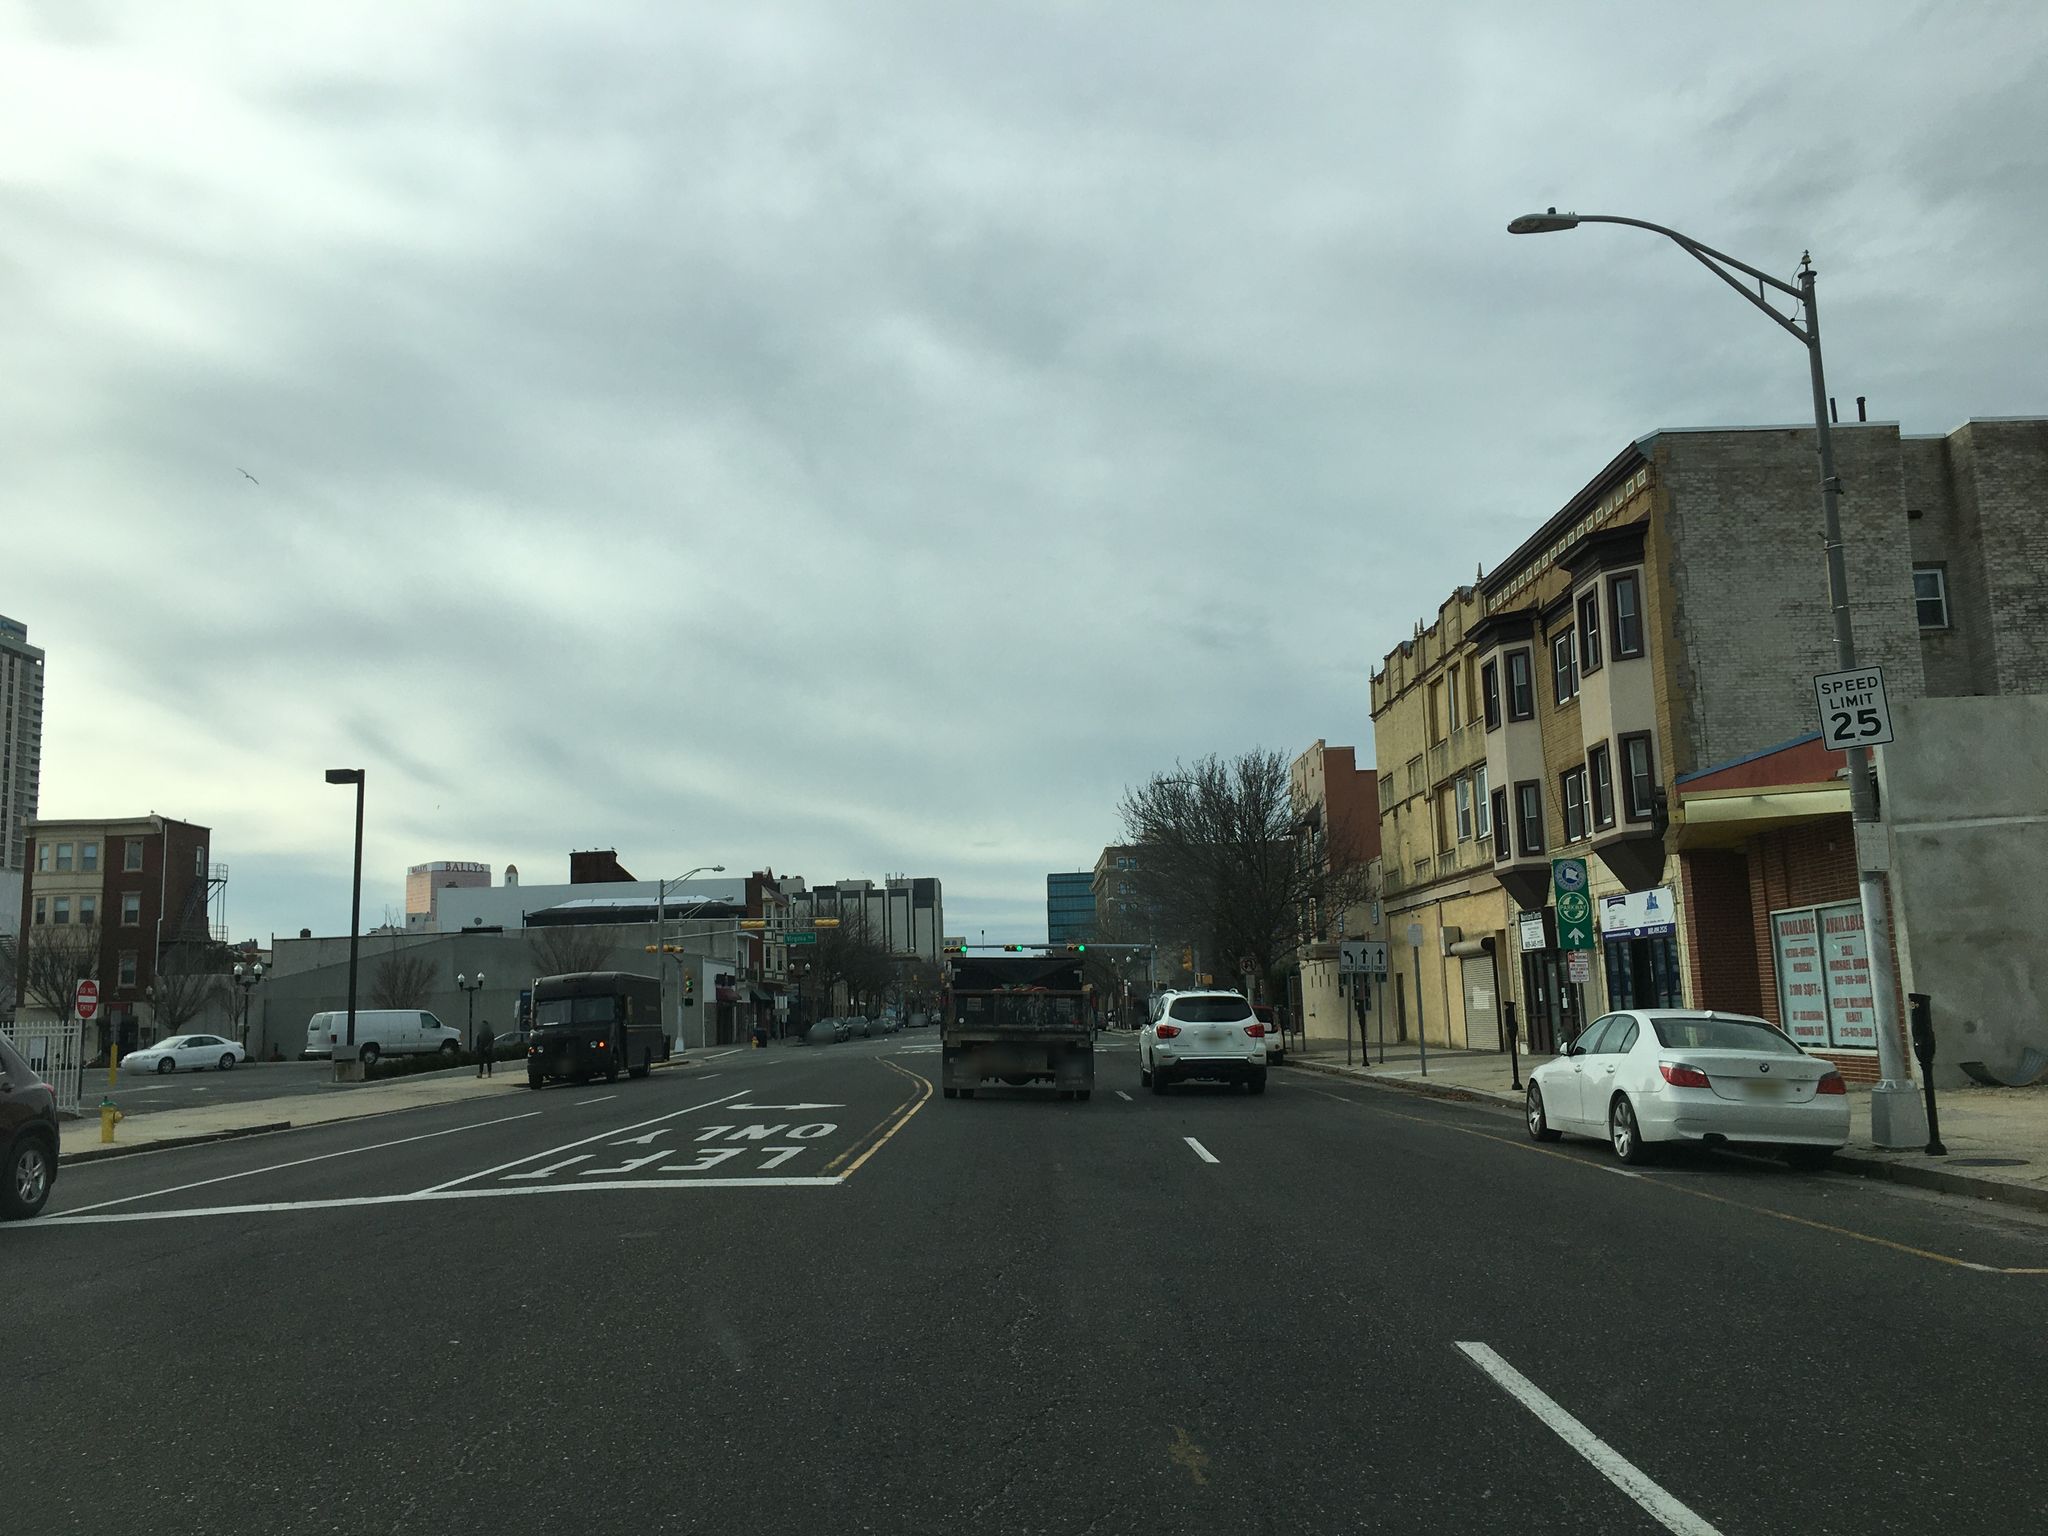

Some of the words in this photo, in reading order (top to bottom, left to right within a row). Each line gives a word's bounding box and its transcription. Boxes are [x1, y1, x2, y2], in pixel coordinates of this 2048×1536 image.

[1821, 677, 1878, 694] SPEED
[1830, 693, 1873, 709] LIMIT
[1831, 708, 1881, 741] 25
[1780, 918, 1815, 936] AVAILABLE
[1826, 914, 1864, 933] AVAILABLE
[1842, 946, 1853, 956] CALL
[80, 986, 87, 994] DO
[88, 987, 96, 995] NOT
[608, 1123, 838, 1145] ONLY
[499, 1146, 808, 1180] LEFT
